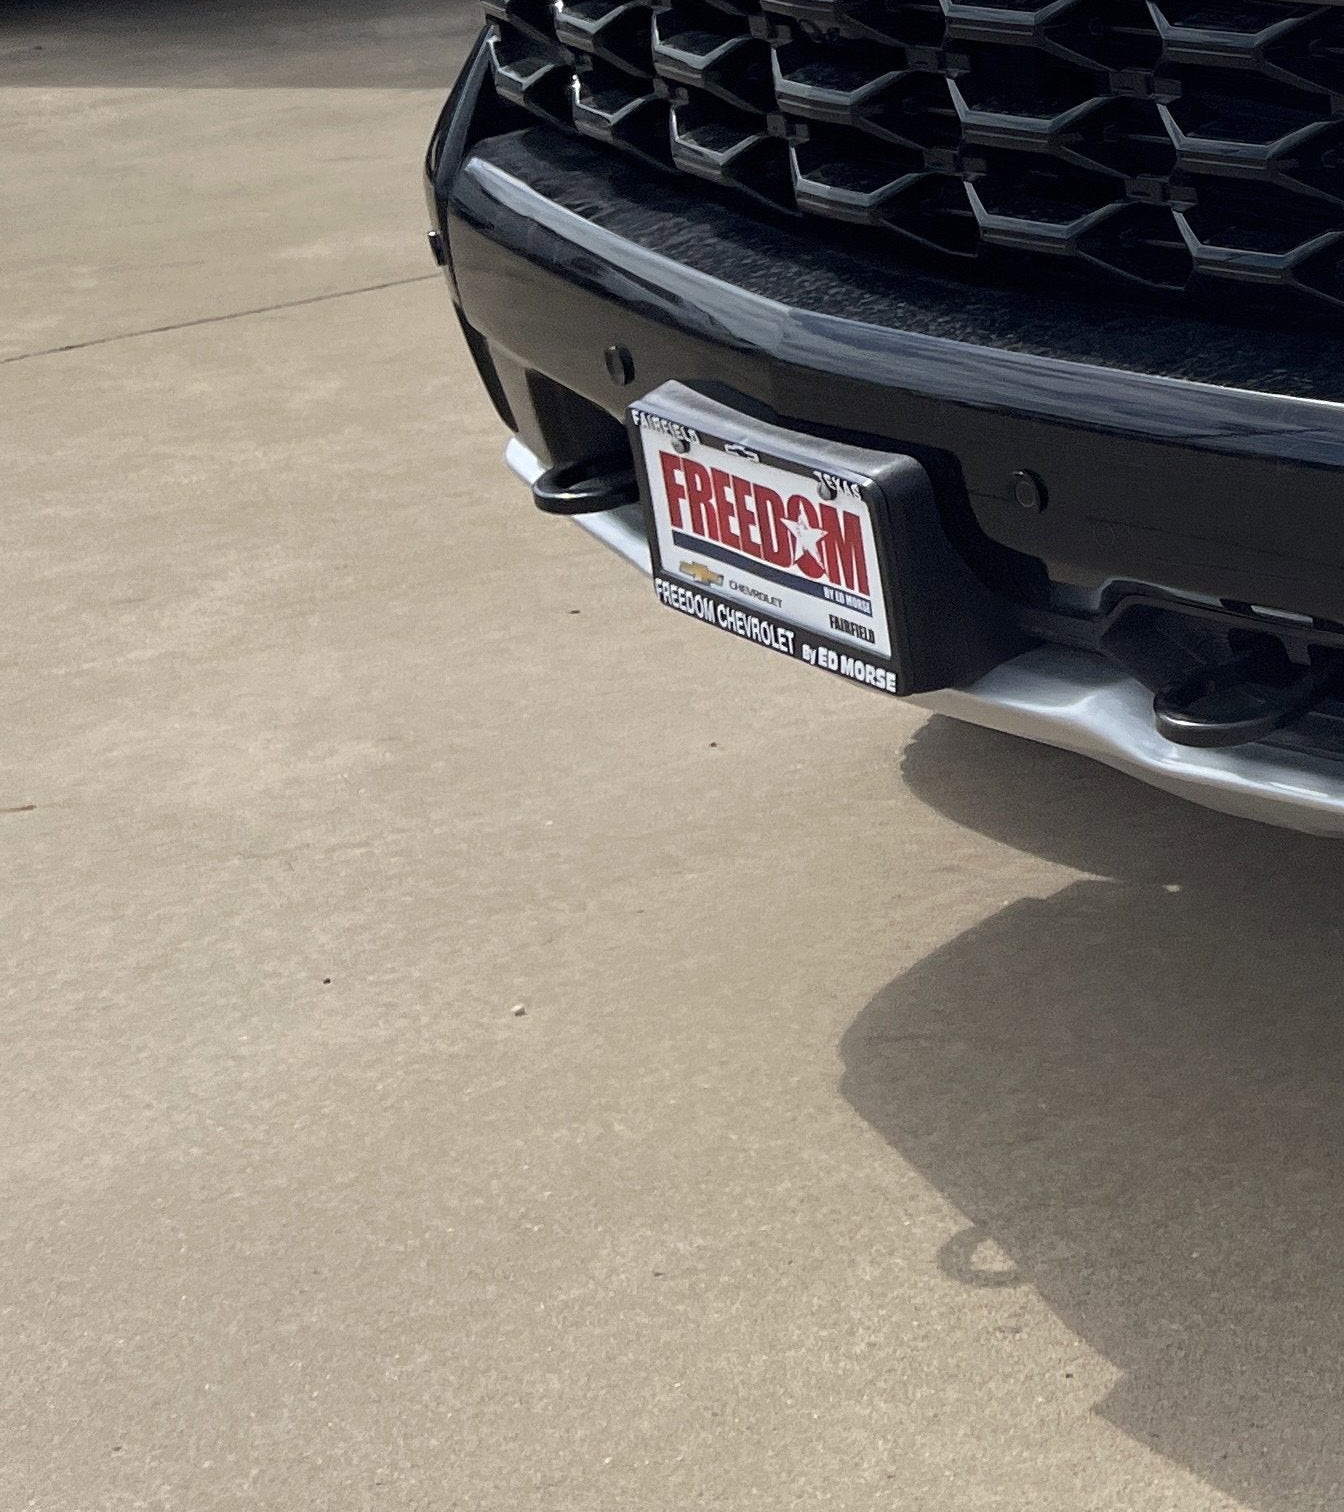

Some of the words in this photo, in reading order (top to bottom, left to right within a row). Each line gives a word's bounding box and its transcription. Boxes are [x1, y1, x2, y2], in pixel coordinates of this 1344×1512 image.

[658, 449, 871, 597] FREEDOM
[654, 577, 716, 624] FREEDOM
[716, 603, 795, 655] CHEVROLET
[817, 646, 839, 671] ED
[840, 654, 897, 693] MORSE
[729, 579, 783, 609] CHEVROLET
